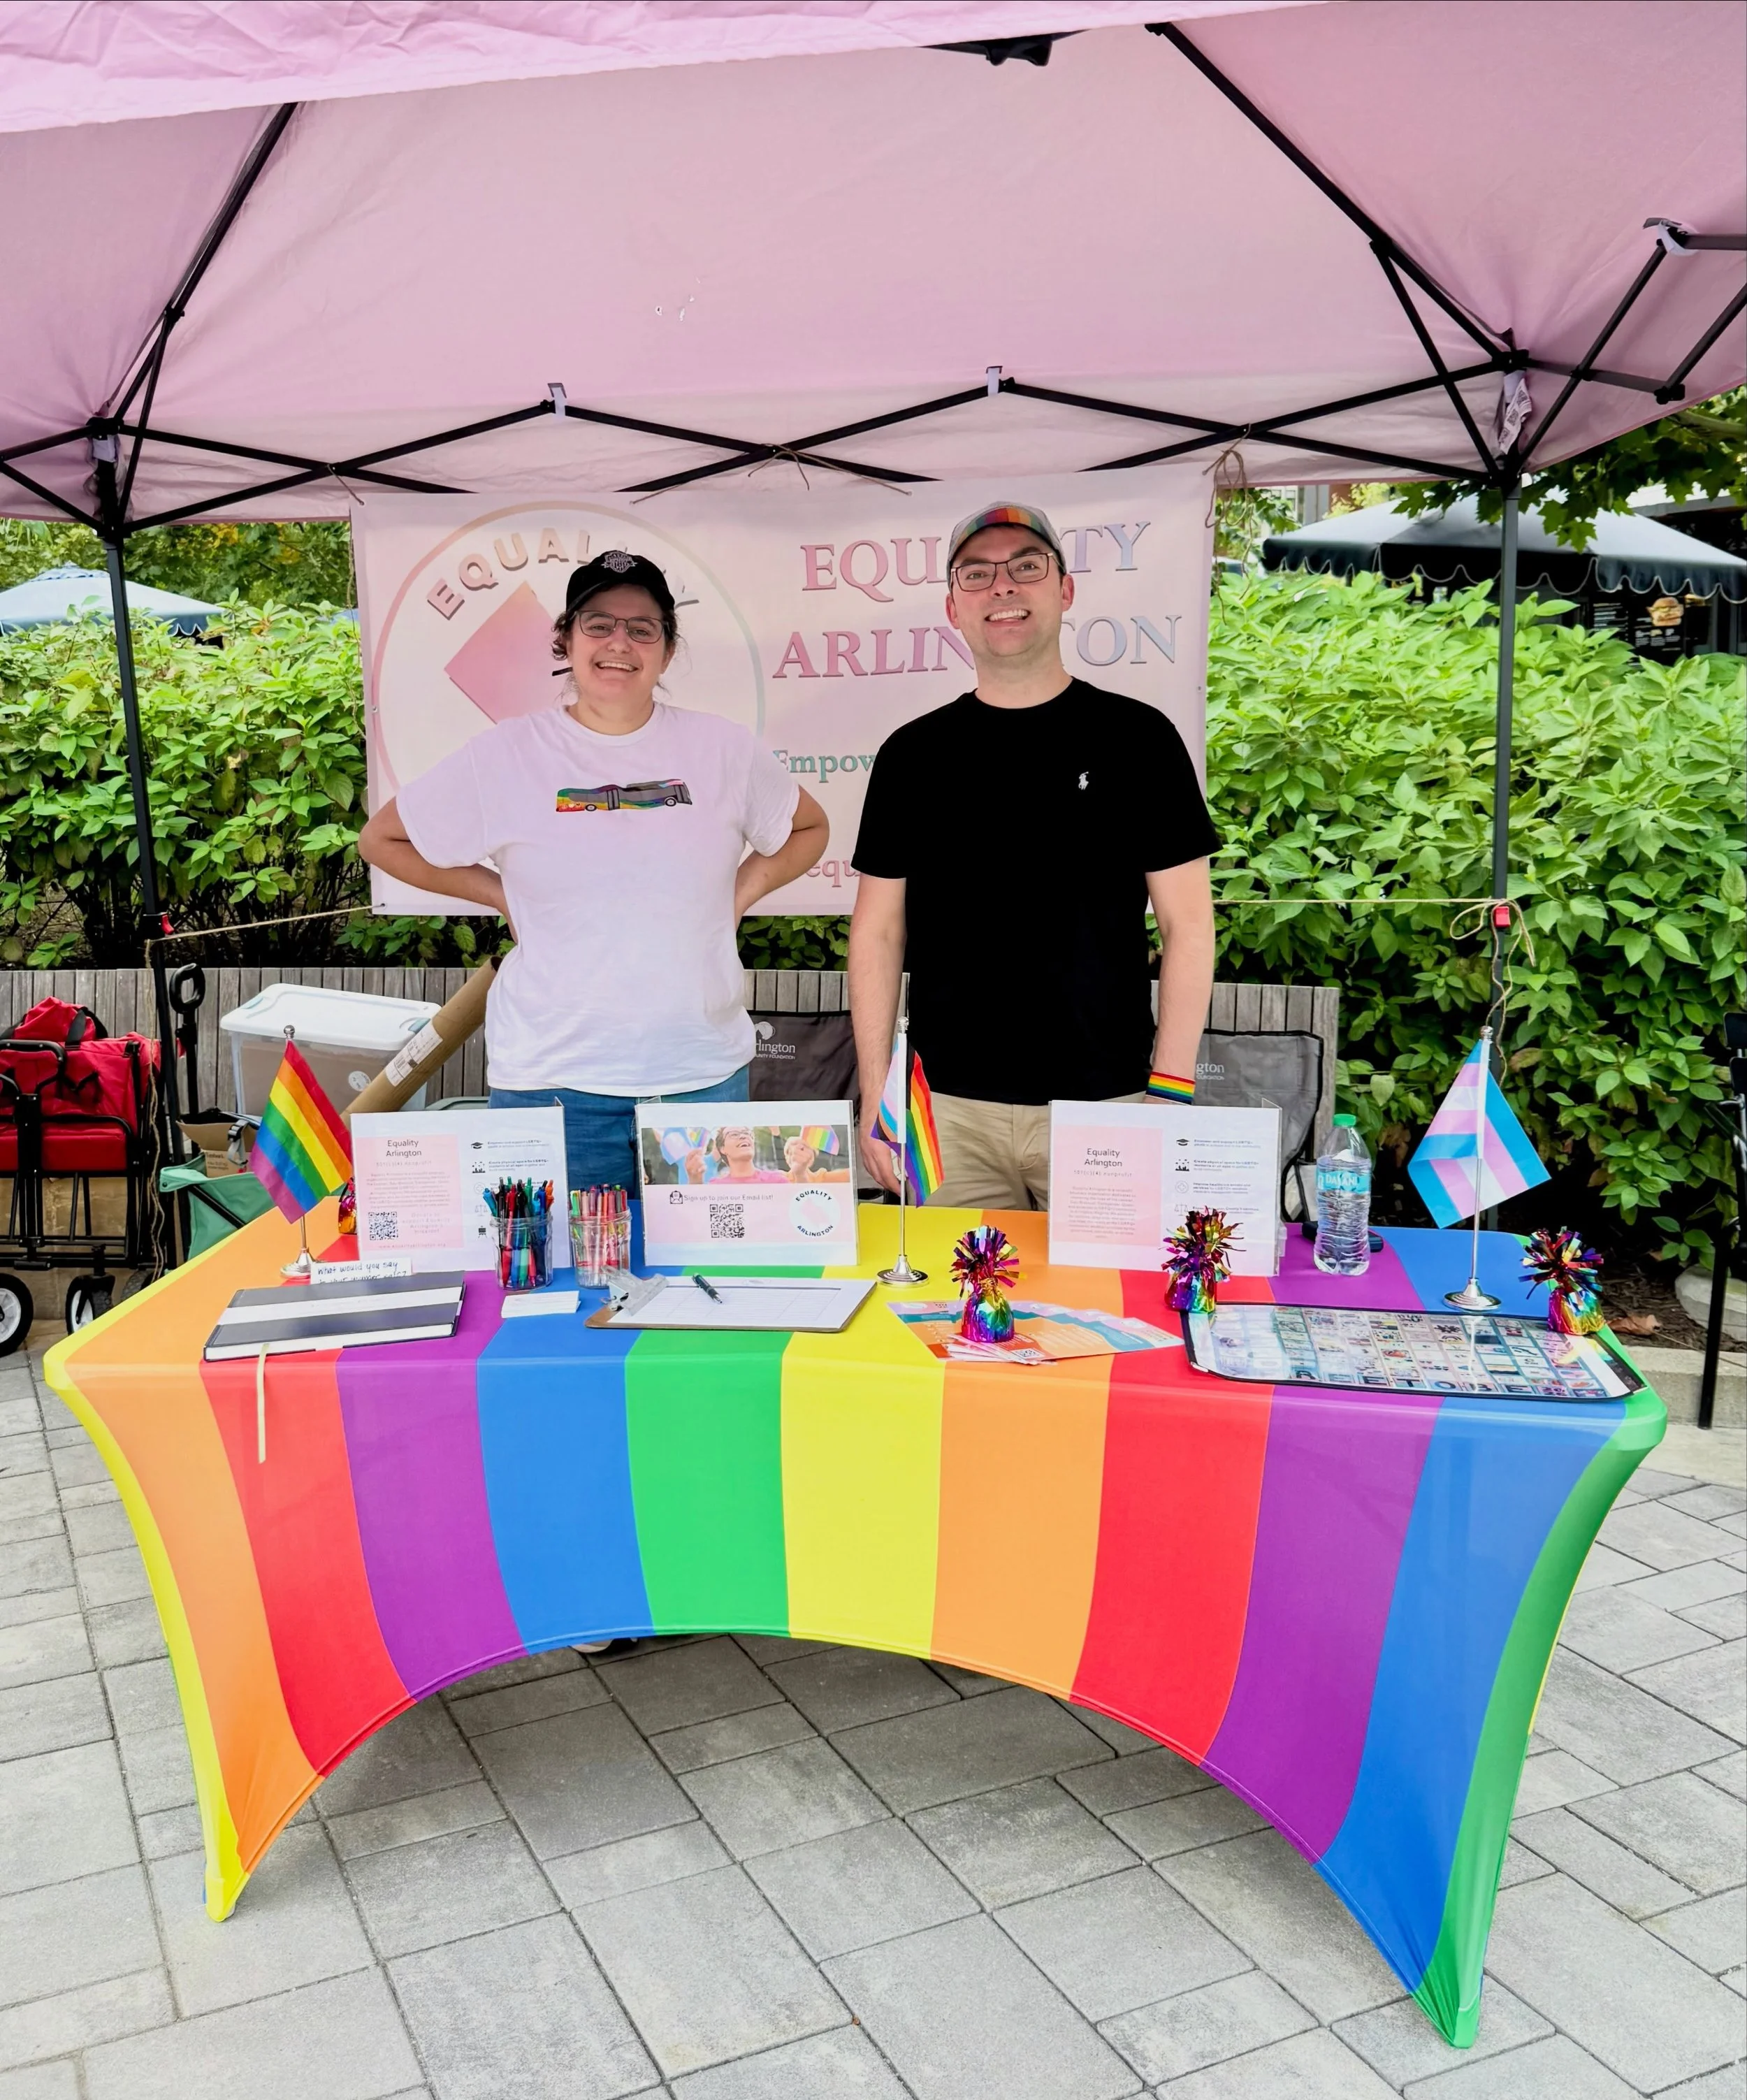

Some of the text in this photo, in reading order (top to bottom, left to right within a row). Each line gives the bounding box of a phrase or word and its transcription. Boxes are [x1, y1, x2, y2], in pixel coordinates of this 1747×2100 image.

[800, 521, 1151, 602] EQUTY
[427, 528, 699, 620] EQUALY
[772, 614, 1182, 679] ARLINON
[387, 1139, 419, 1148] Equality
[1087, 1148, 1120, 1158] Equality
[1085, 1159, 1122, 1168] Arlington
[795, 1189, 832, 1201] EQUALITY
[797, 1225, 834, 1237] ARLINGTON
[366, 1263, 379, 1273] you
[383, 1261, 398, 1272] say
